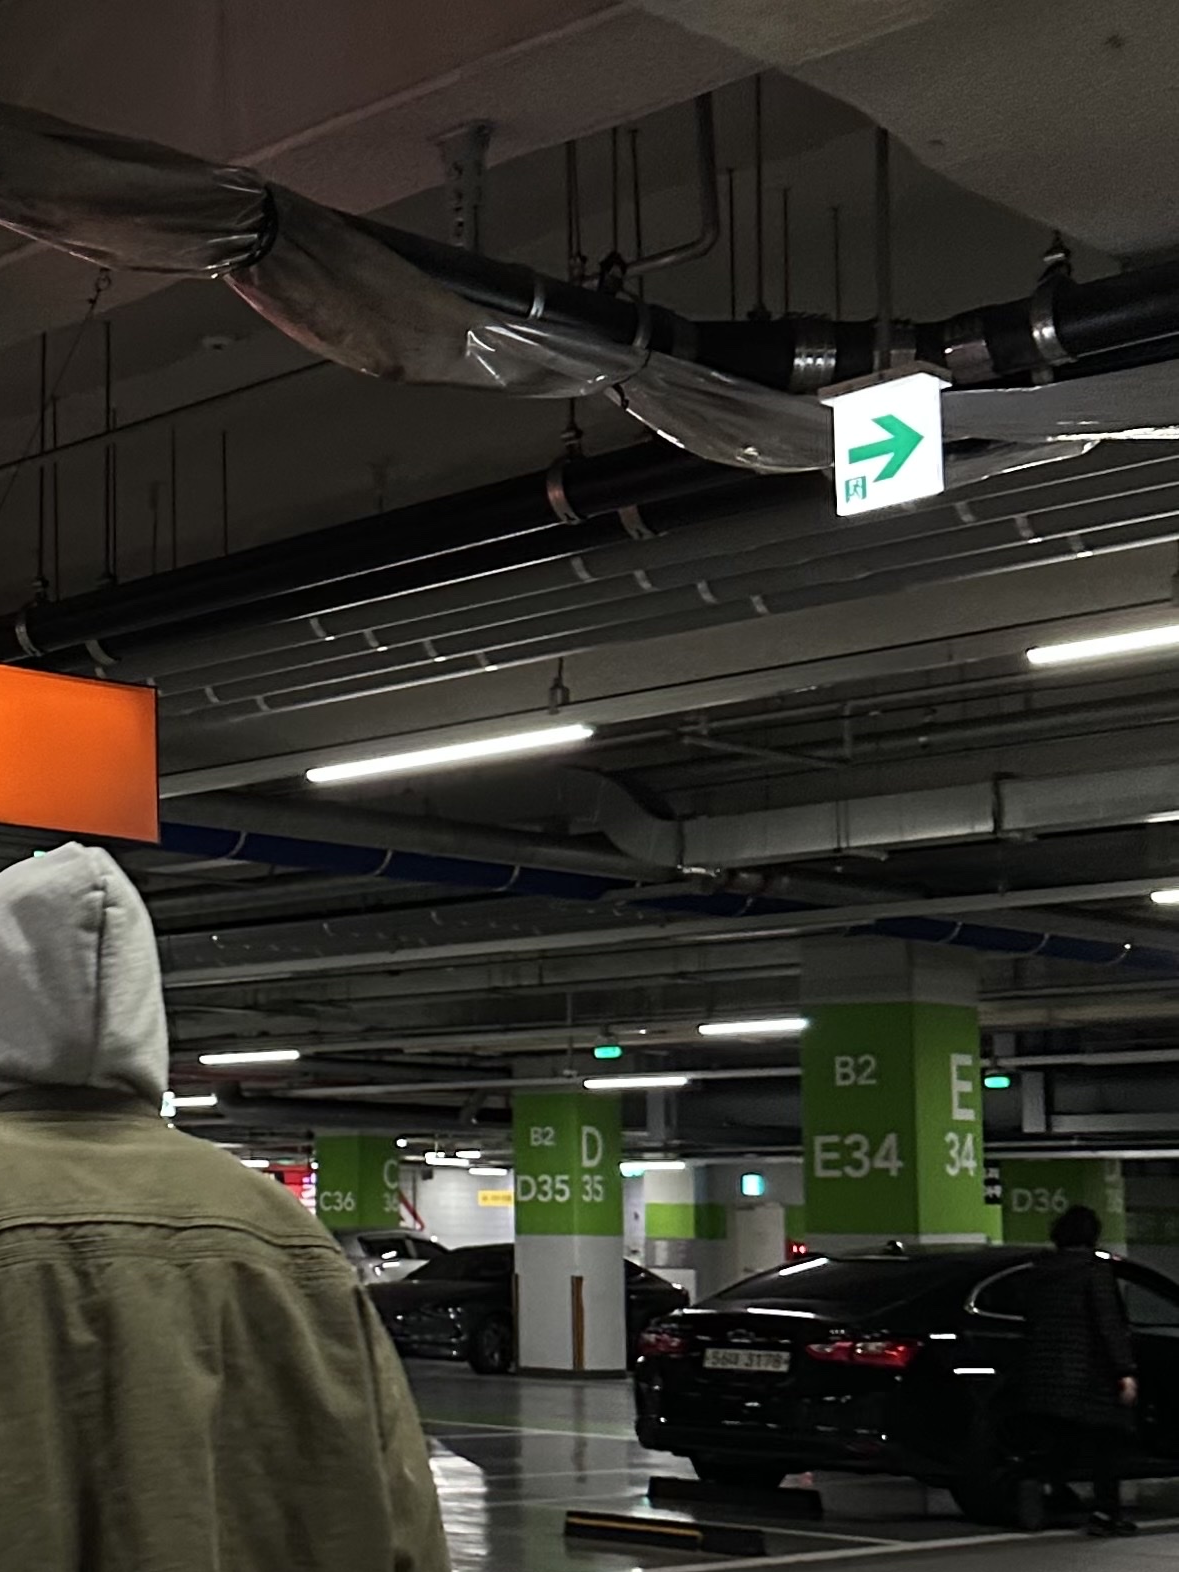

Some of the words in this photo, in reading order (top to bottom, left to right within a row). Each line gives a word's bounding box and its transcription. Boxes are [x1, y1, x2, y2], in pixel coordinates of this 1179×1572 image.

[834, 1055, 877, 1086] B2
[950, 1053, 976, 1121] E
[529, 1127, 556, 1147] B2
[581, 1126, 603, 1168] D
[812, 1133, 904, 1178] E34
[944, 1132, 977, 1177] 34
[321, 1191, 356, 1211] C36
[516, 1175, 570, 1202] D35
[581, 1175, 604, 1202] 35
[1010, 1187, 1069, 1213] D36
